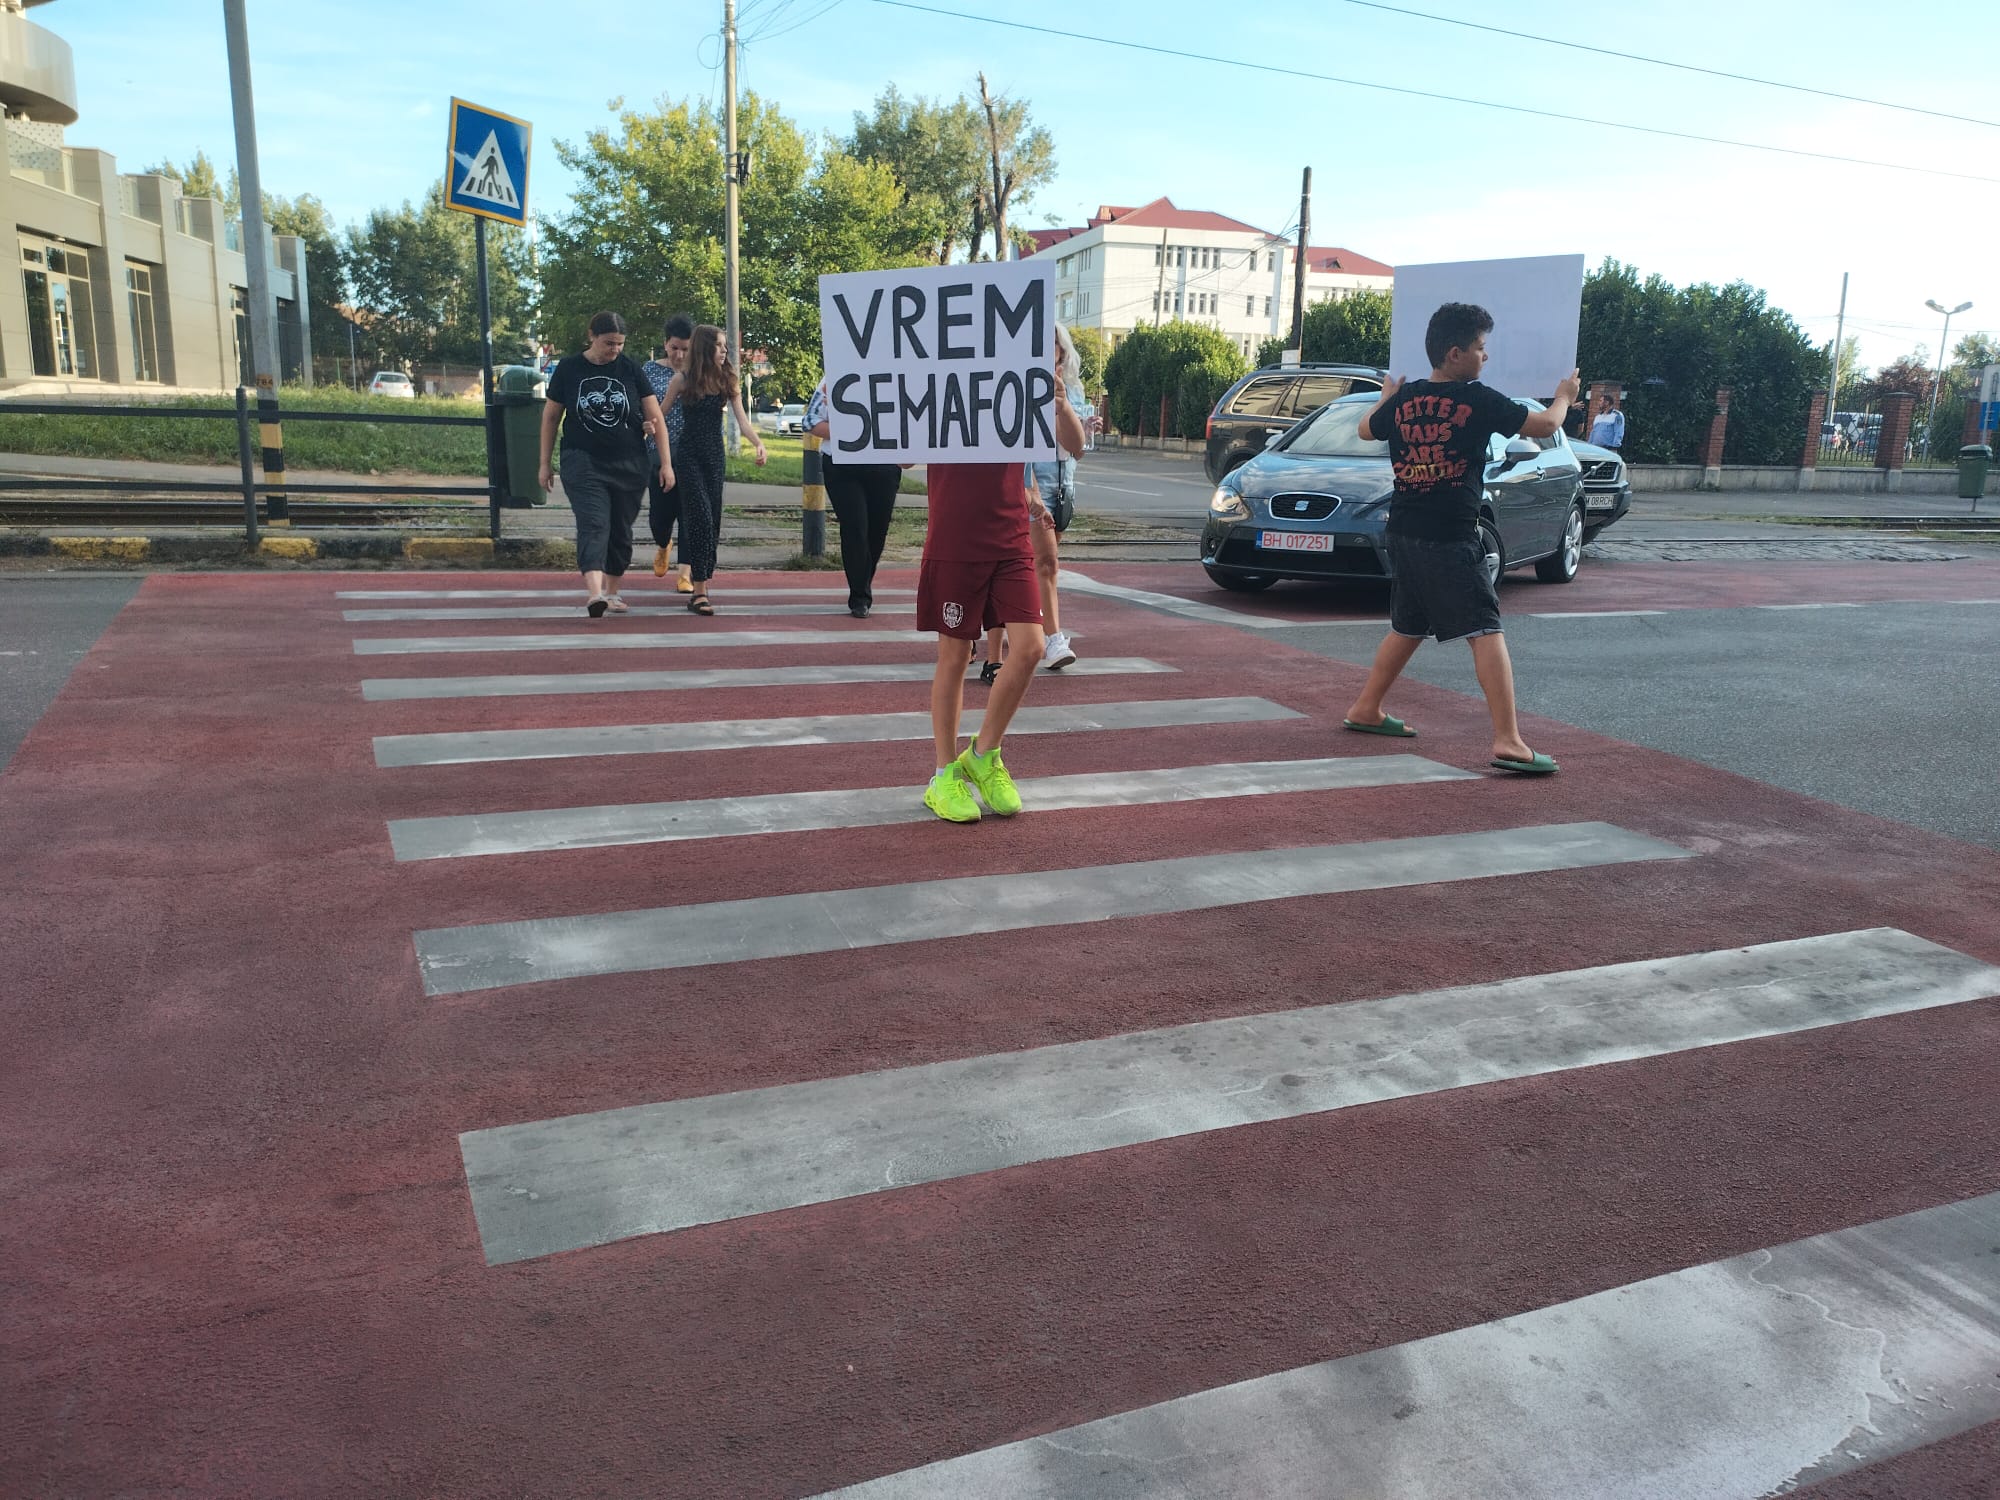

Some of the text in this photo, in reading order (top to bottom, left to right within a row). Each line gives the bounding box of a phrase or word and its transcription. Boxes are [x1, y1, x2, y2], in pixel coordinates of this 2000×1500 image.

[832, 279, 1044, 360] VREM
[831, 367, 1056, 452] SEMAFOR
[1400, 422, 1452, 443] DAYS
[1263, 533, 1281, 547] BH
[1286, 534, 1329, 550] 017251
